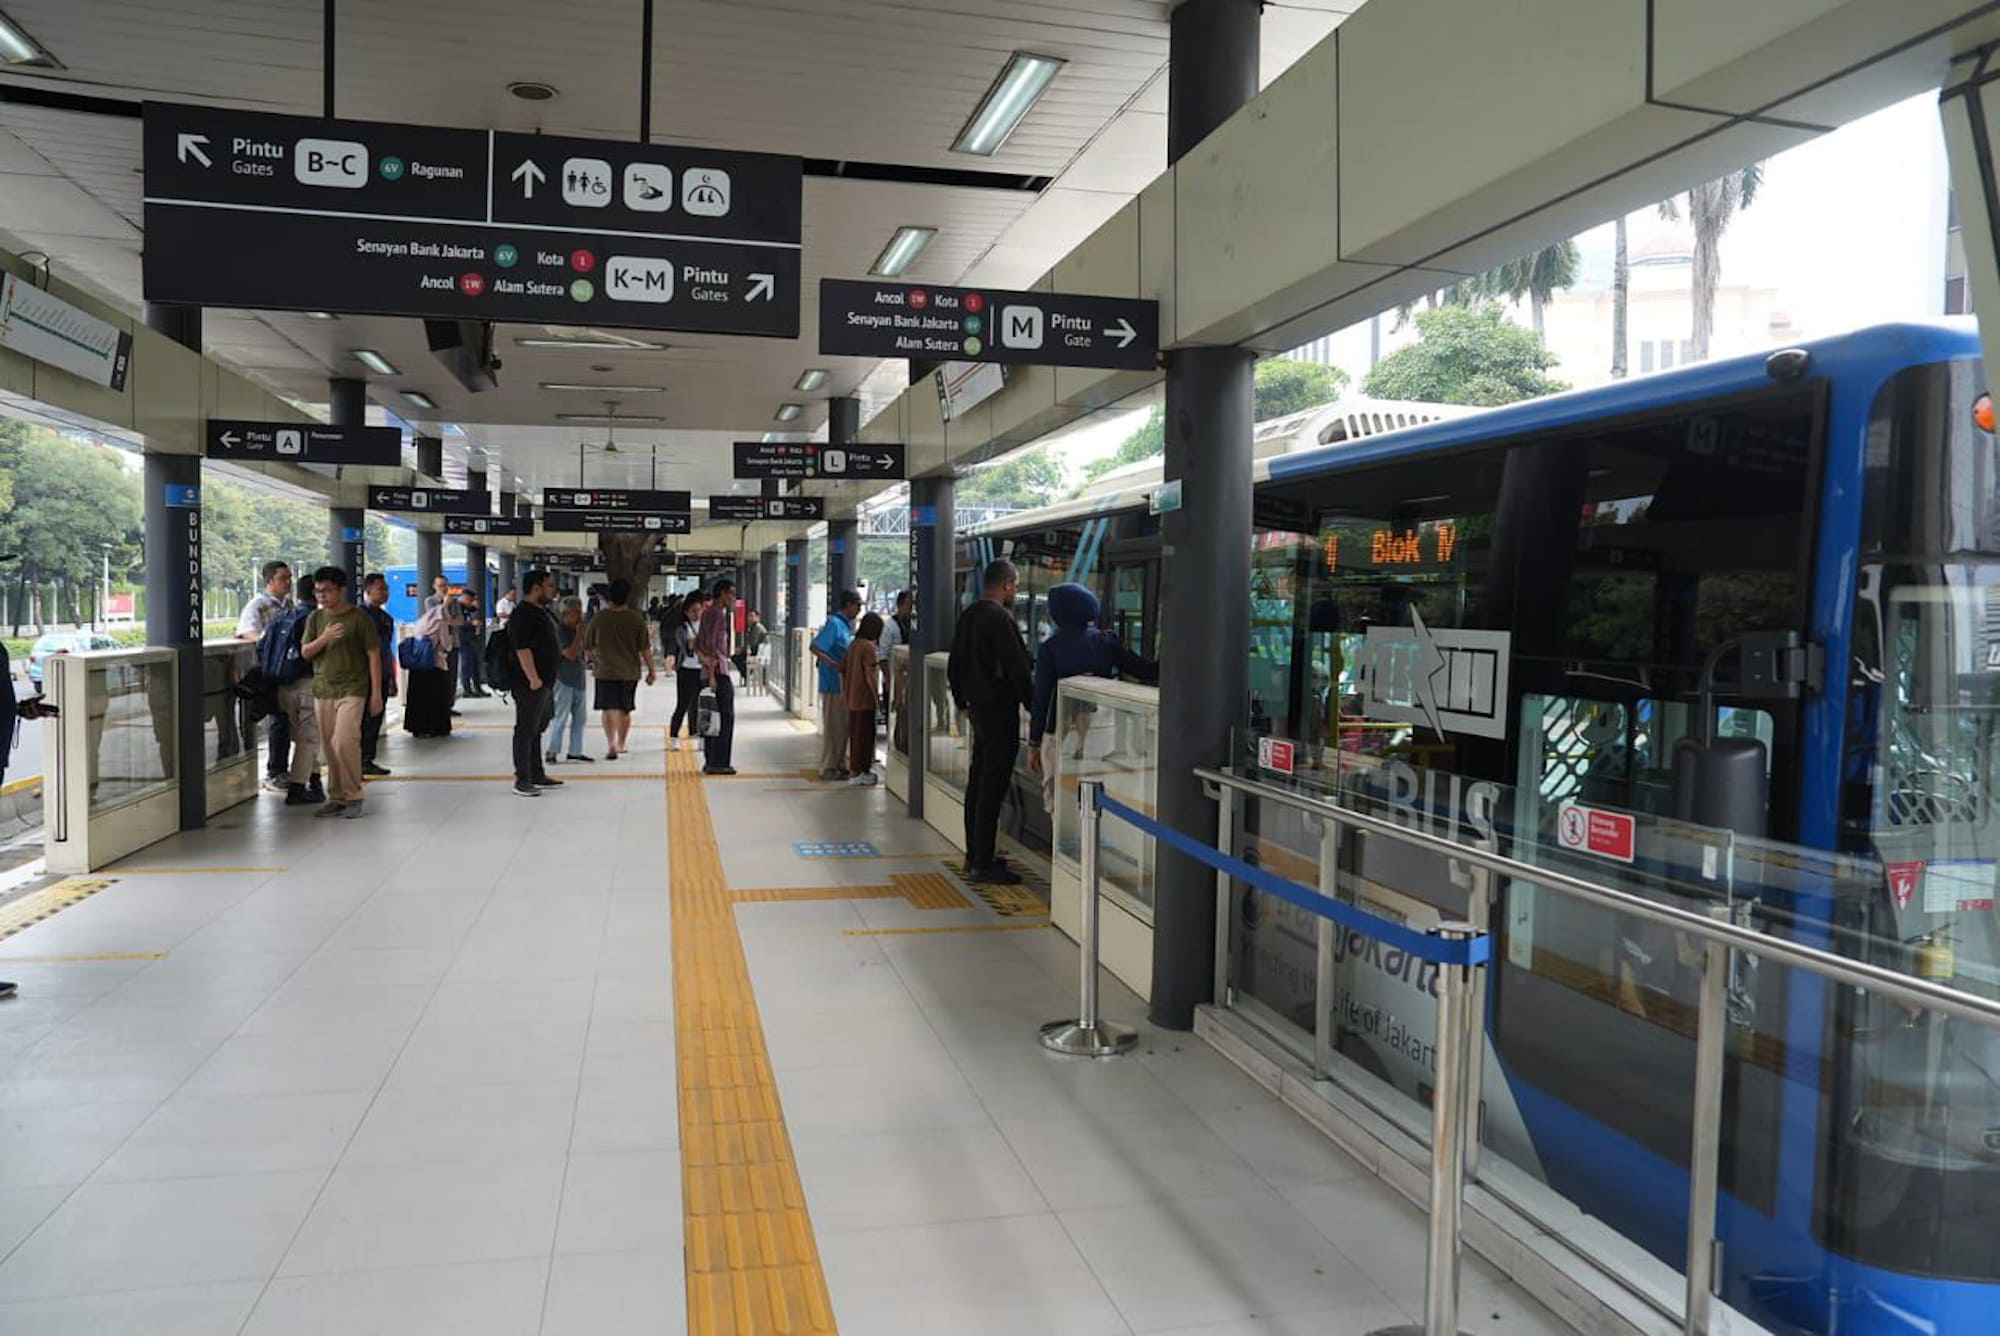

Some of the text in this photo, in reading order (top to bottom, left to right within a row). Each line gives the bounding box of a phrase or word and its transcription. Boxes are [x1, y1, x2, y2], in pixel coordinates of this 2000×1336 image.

[233, 138, 283, 159] Pintu
[232, 160, 274, 177] Gates
[411, 162, 463, 179] Ragunan
[357, 238, 408, 257] Senayan
[410, 242, 440, 256] Bank
[441, 244, 485, 259] Jakarta
[537, 251, 564, 266] Kota
[684, 267, 729, 285] Pintu
[421, 274, 454, 290] Ancol
[494, 280, 524, 293] Alam
[526, 280, 565, 296] Sutera
[691, 287, 728, 302] Gates
[874, 291, 905, 305] Ancol
[935, 294, 959, 308] Kota
[847, 311, 892, 329] Senayan
[894, 314, 920, 328] Bank
[921, 315, 959, 330] Jakarta
[1012, 315, 1033, 338] M
[1051, 313, 1092, 331] Pintu
[895, 335, 922, 349] Alam
[924, 337, 959, 351] Sutera
[1064, 333, 1092, 347] Gate
[283, 436, 294, 449] A
[830, 456, 839, 468] L
[188, 512, 200, 639] BUNDARAN
